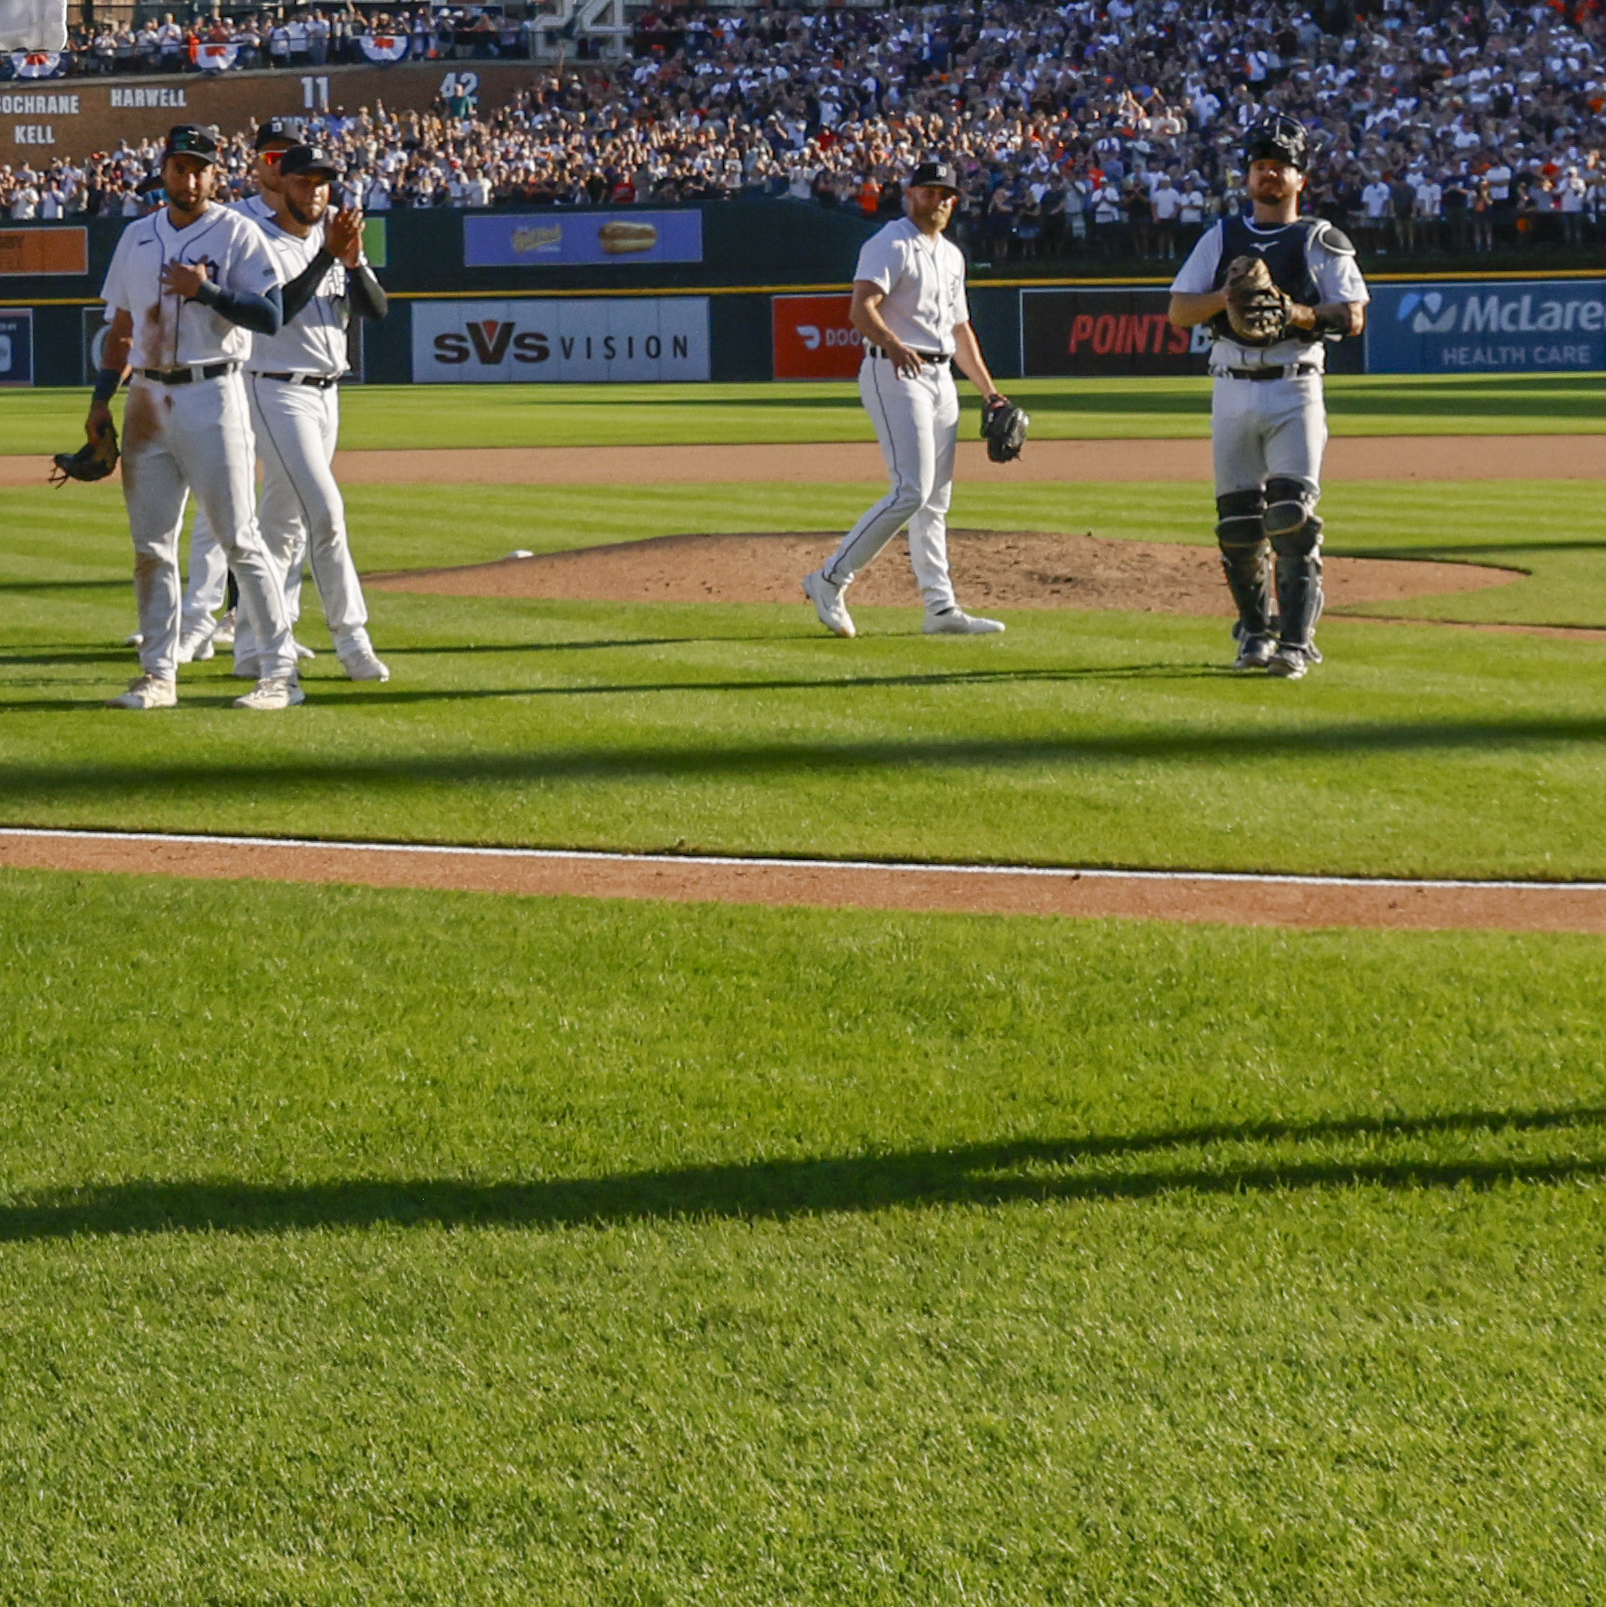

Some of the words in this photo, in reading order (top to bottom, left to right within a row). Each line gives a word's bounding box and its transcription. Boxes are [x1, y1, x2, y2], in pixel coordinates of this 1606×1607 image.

[110, 87, 187, 108] HARWELL
[299, 75, 330, 109] 11
[439, 71, 481, 106] 42
[13, 125, 56, 145] KELL
[1461, 295, 1606, 333] McLare
[559, 334, 689, 361] VISION
[1442, 345, 1526, 366] HEALTH
[1533, 344, 1591, 365] CARE
